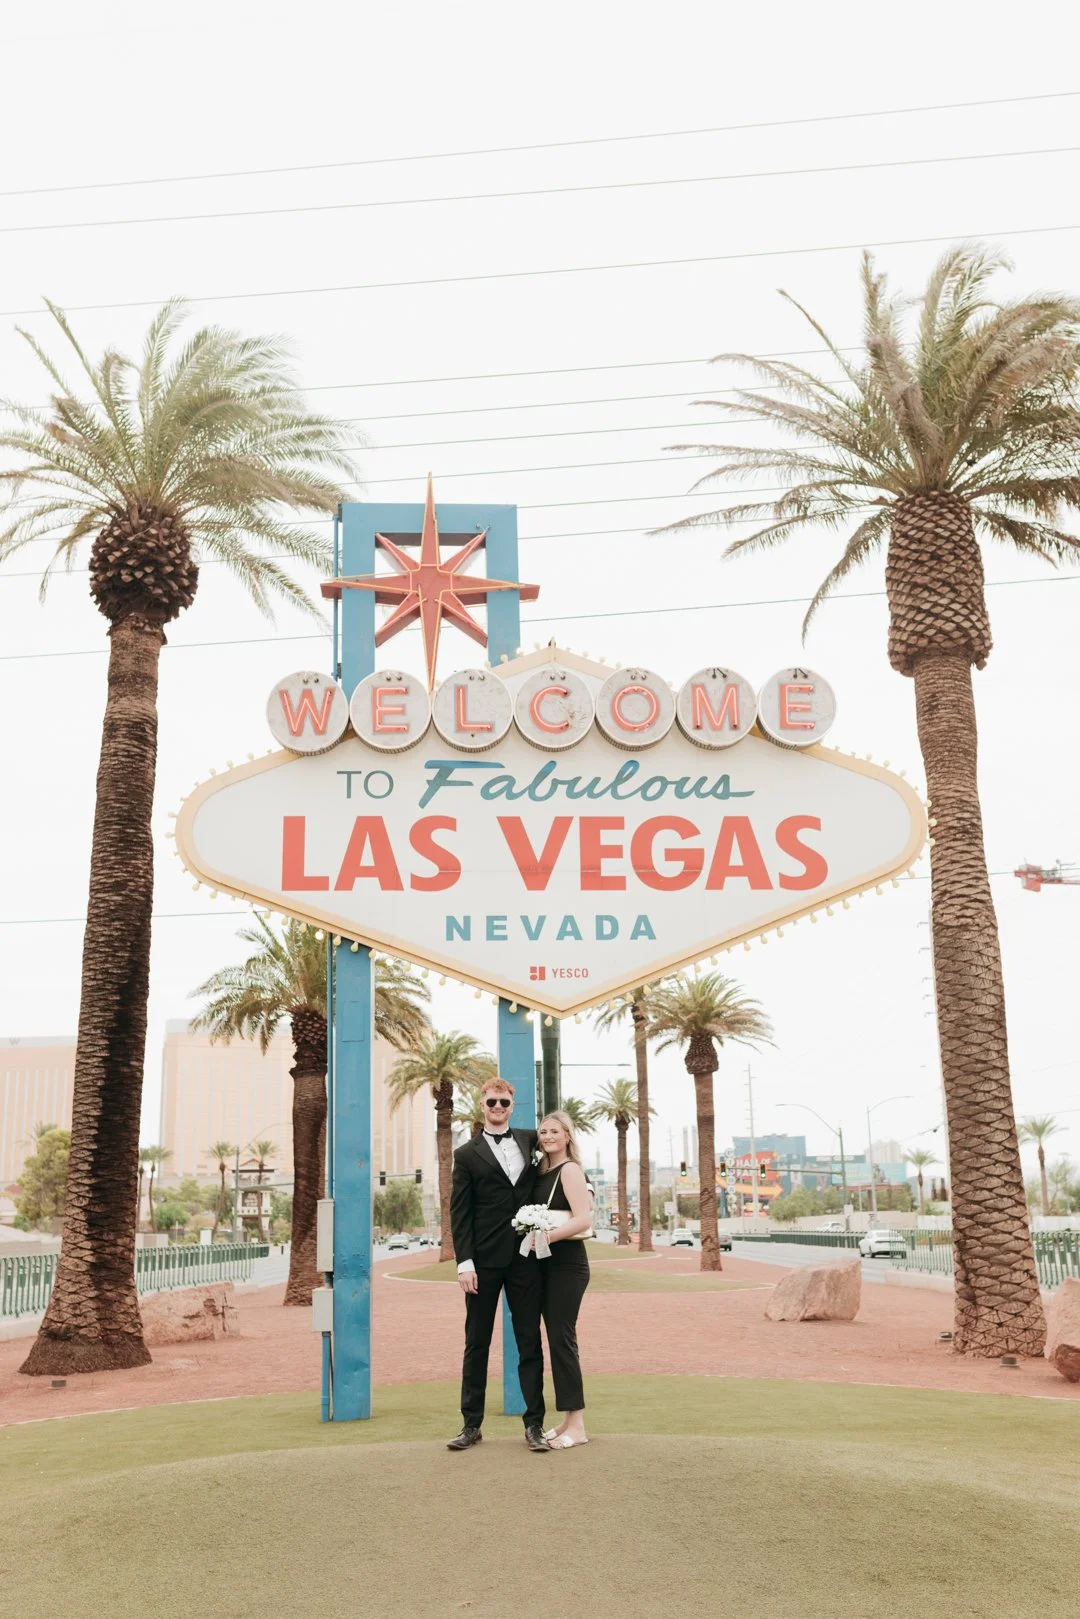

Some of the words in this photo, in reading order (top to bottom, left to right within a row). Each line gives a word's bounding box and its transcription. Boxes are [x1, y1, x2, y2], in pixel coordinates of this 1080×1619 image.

[278, 683, 815, 738] WELCOME
[336, 769, 395, 801] TO
[417, 759, 756, 810] Fabulous
[281, 815, 462, 893] LAS
[497, 814, 829, 893] VEGAS
[445, 915, 657, 942] NEVADA
[551, 967, 589, 979] YESCO
